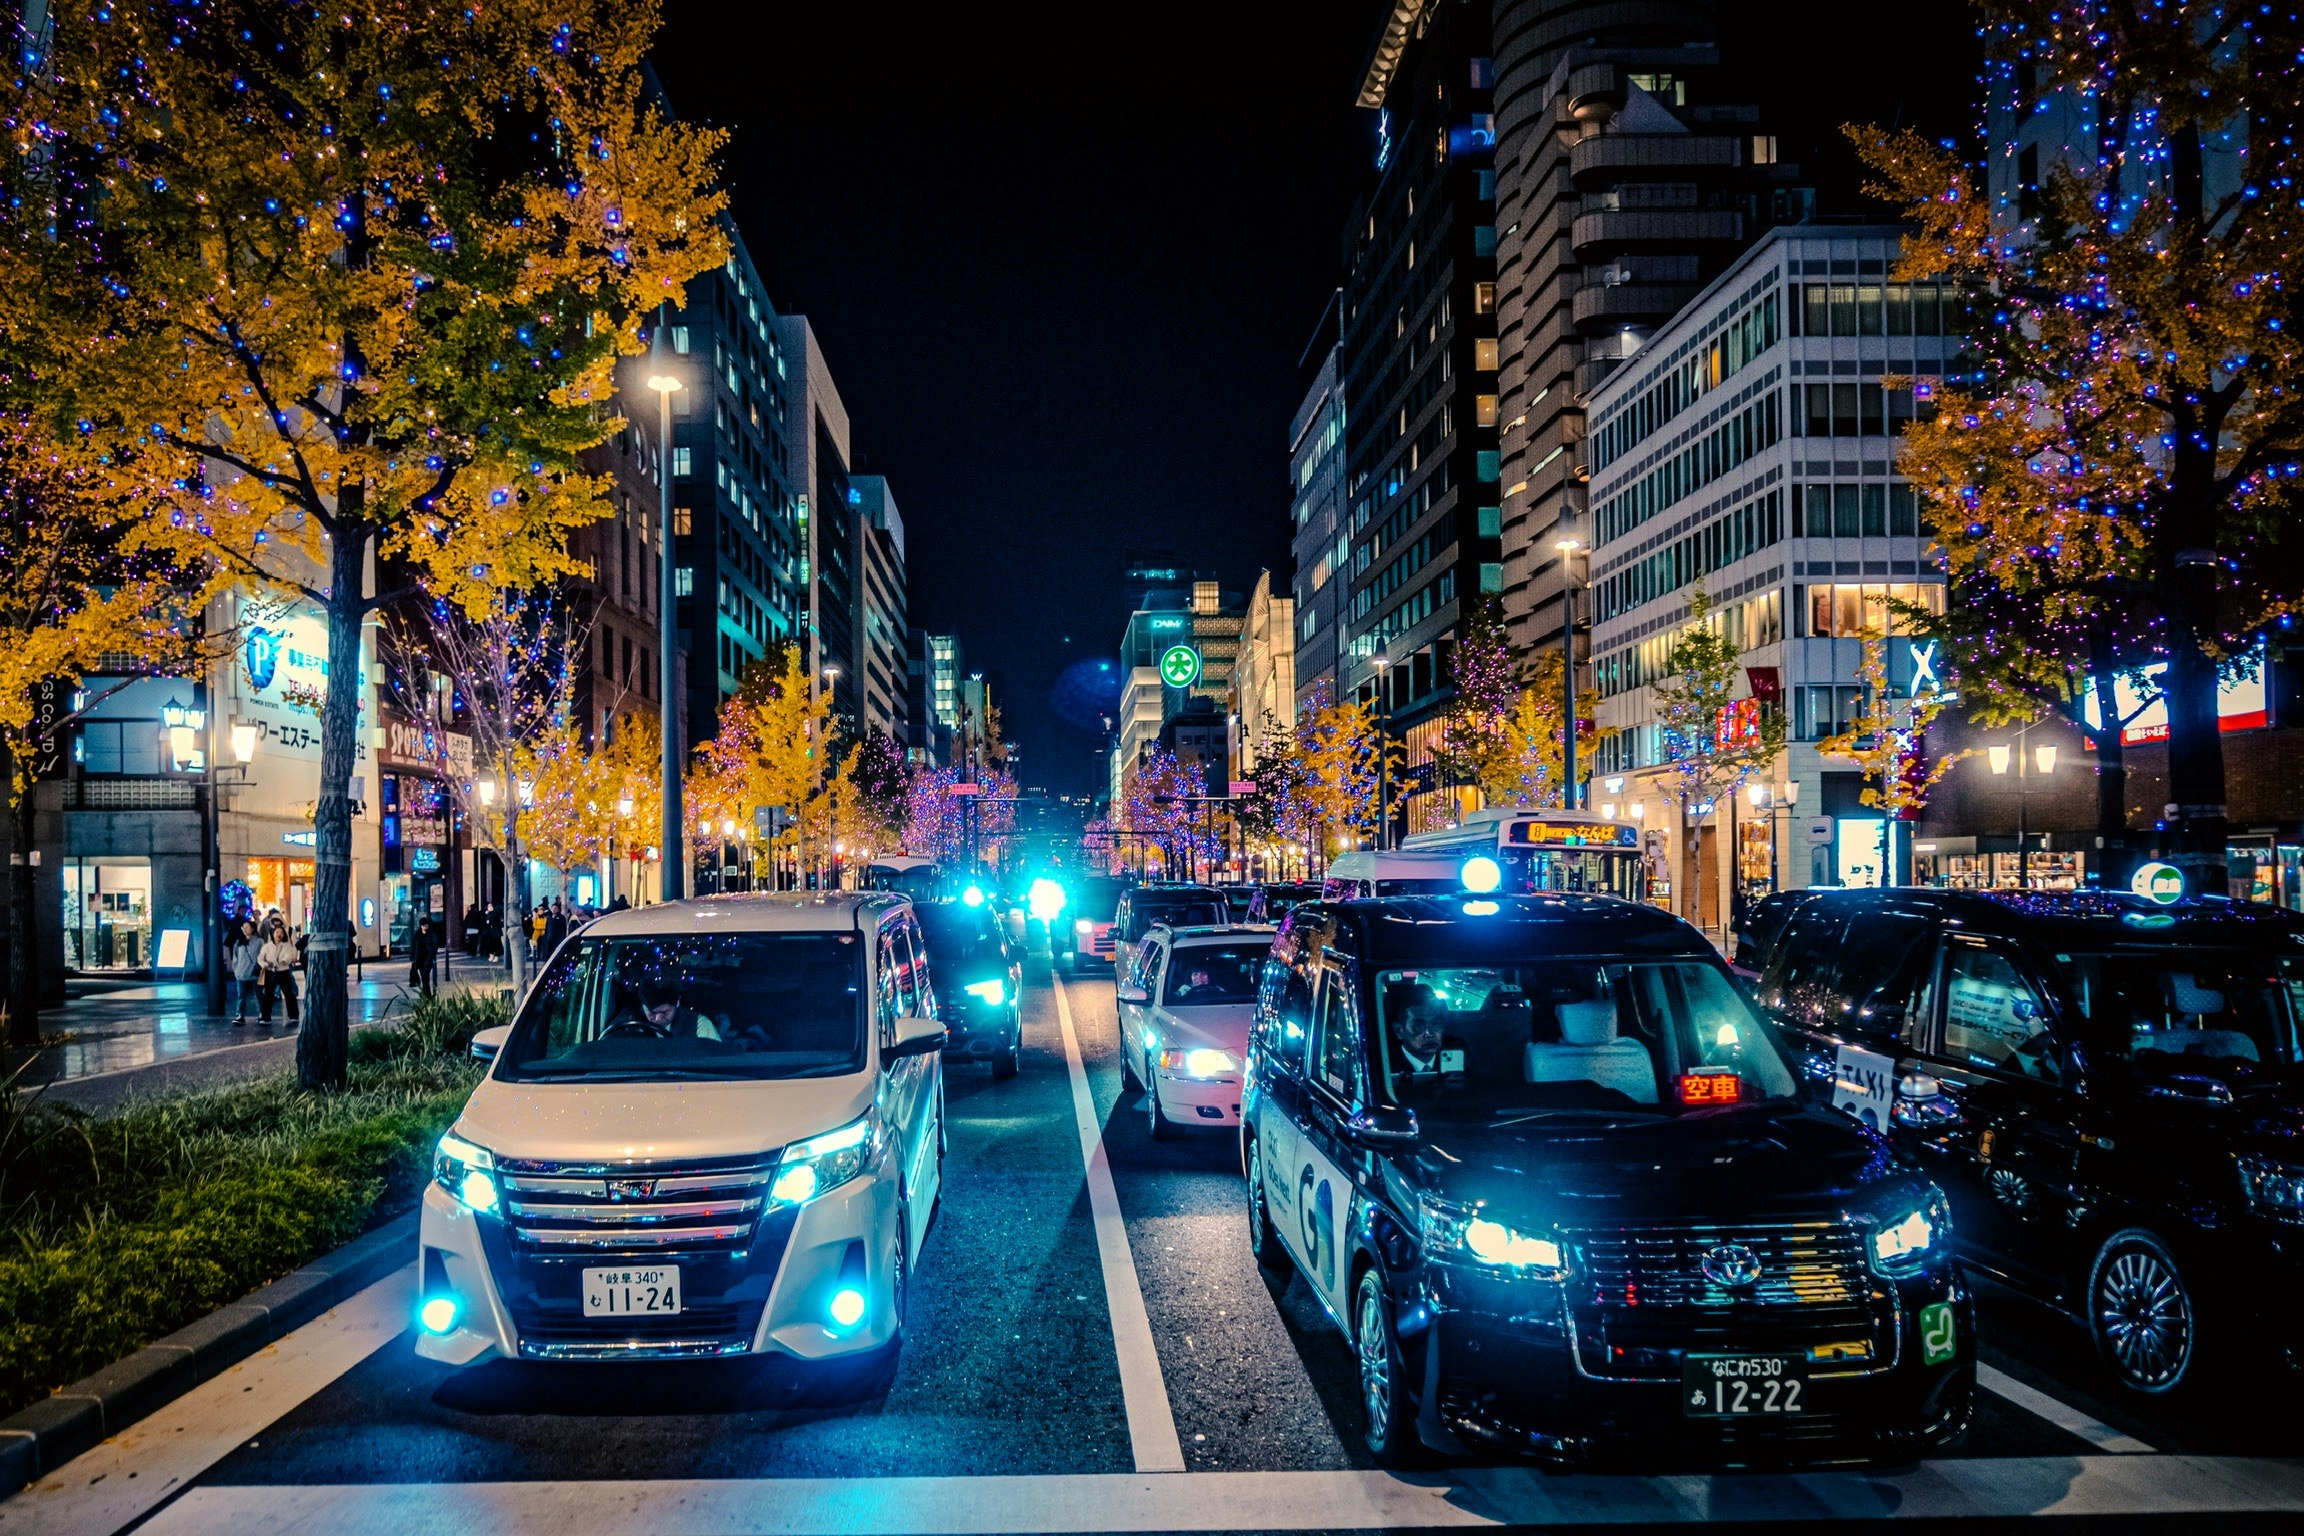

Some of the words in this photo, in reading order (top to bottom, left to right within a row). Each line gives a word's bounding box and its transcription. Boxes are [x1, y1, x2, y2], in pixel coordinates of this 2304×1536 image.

[1684, 1076, 1738, 1100] 空車
[1843, 1064, 1885, 1102] TAXI
[590, 1295, 601, 1307] む
[609, 1287, 675, 1312] 11-24
[1691, 1389, 1706, 1405] あ
[1716, 1379, 1801, 1412] 12-22
